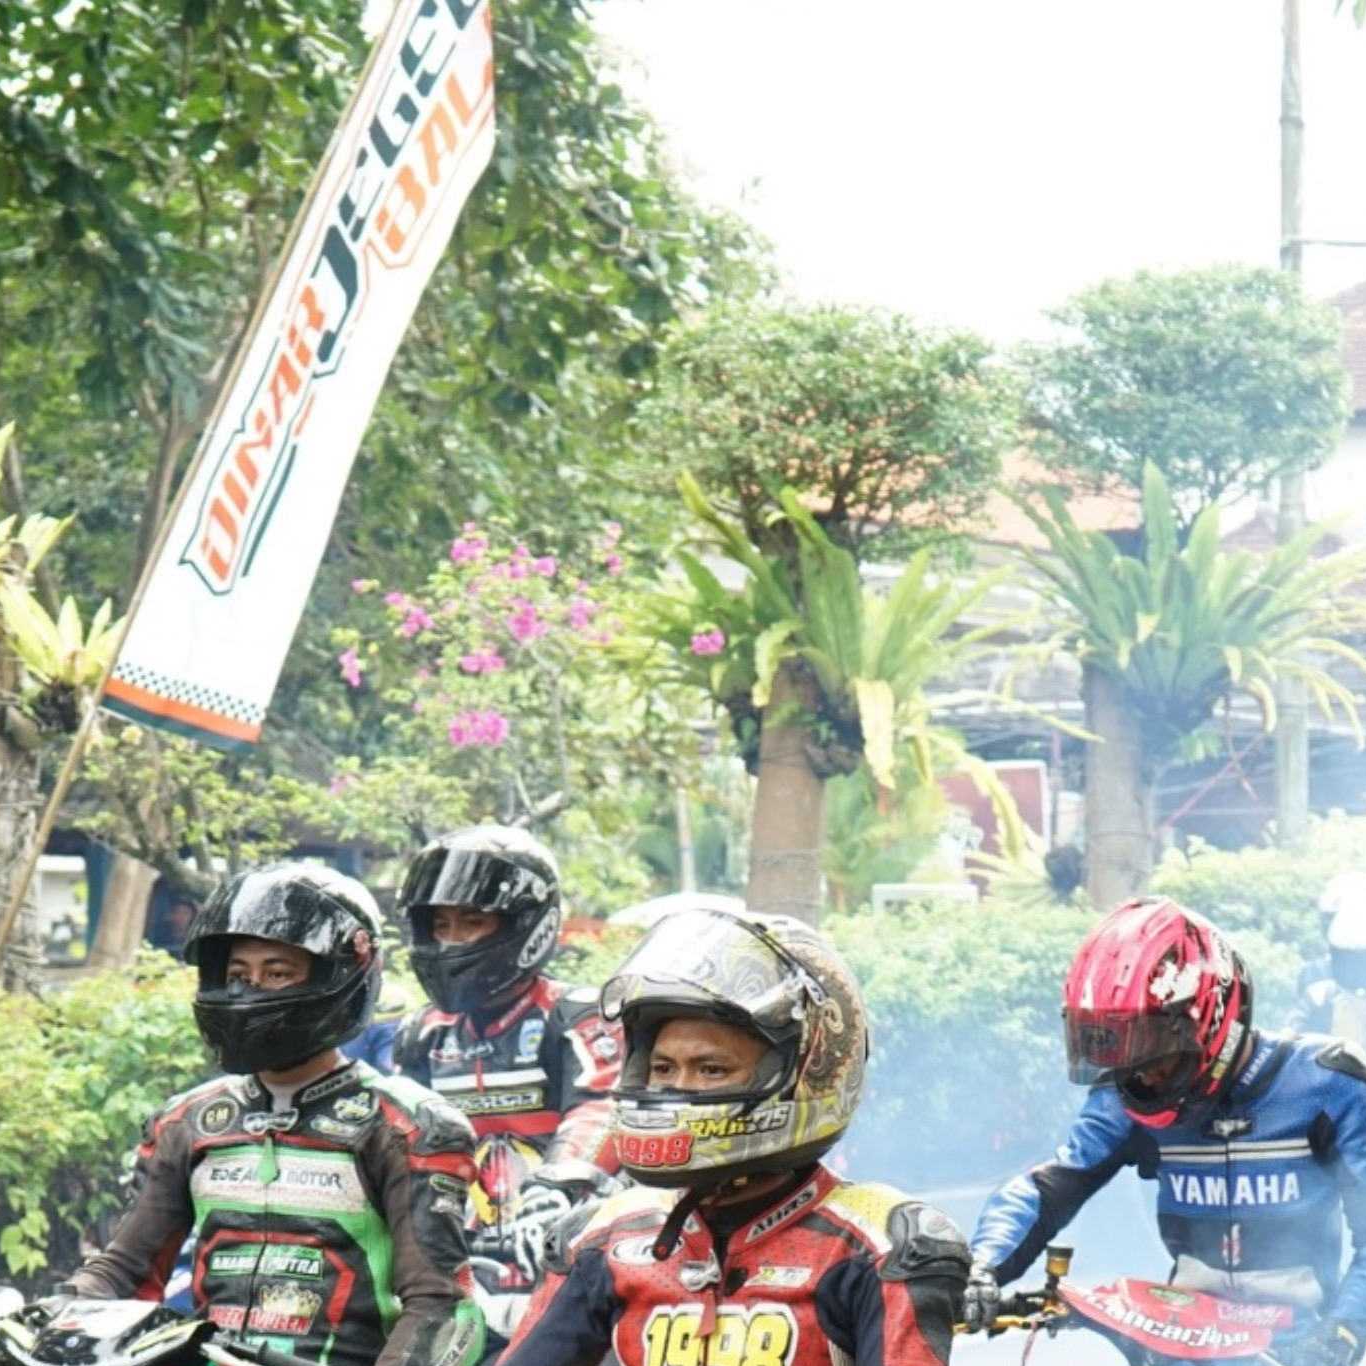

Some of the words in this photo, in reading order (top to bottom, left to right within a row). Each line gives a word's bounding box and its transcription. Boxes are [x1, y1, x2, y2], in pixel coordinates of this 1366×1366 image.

[198, 284, 327, 582] DINAR
[1239, 1046, 1274, 1085] YAMAHA
[286, 1170, 343, 1189] MOTOR
[1168, 1171, 1301, 1207] YAMAHA
